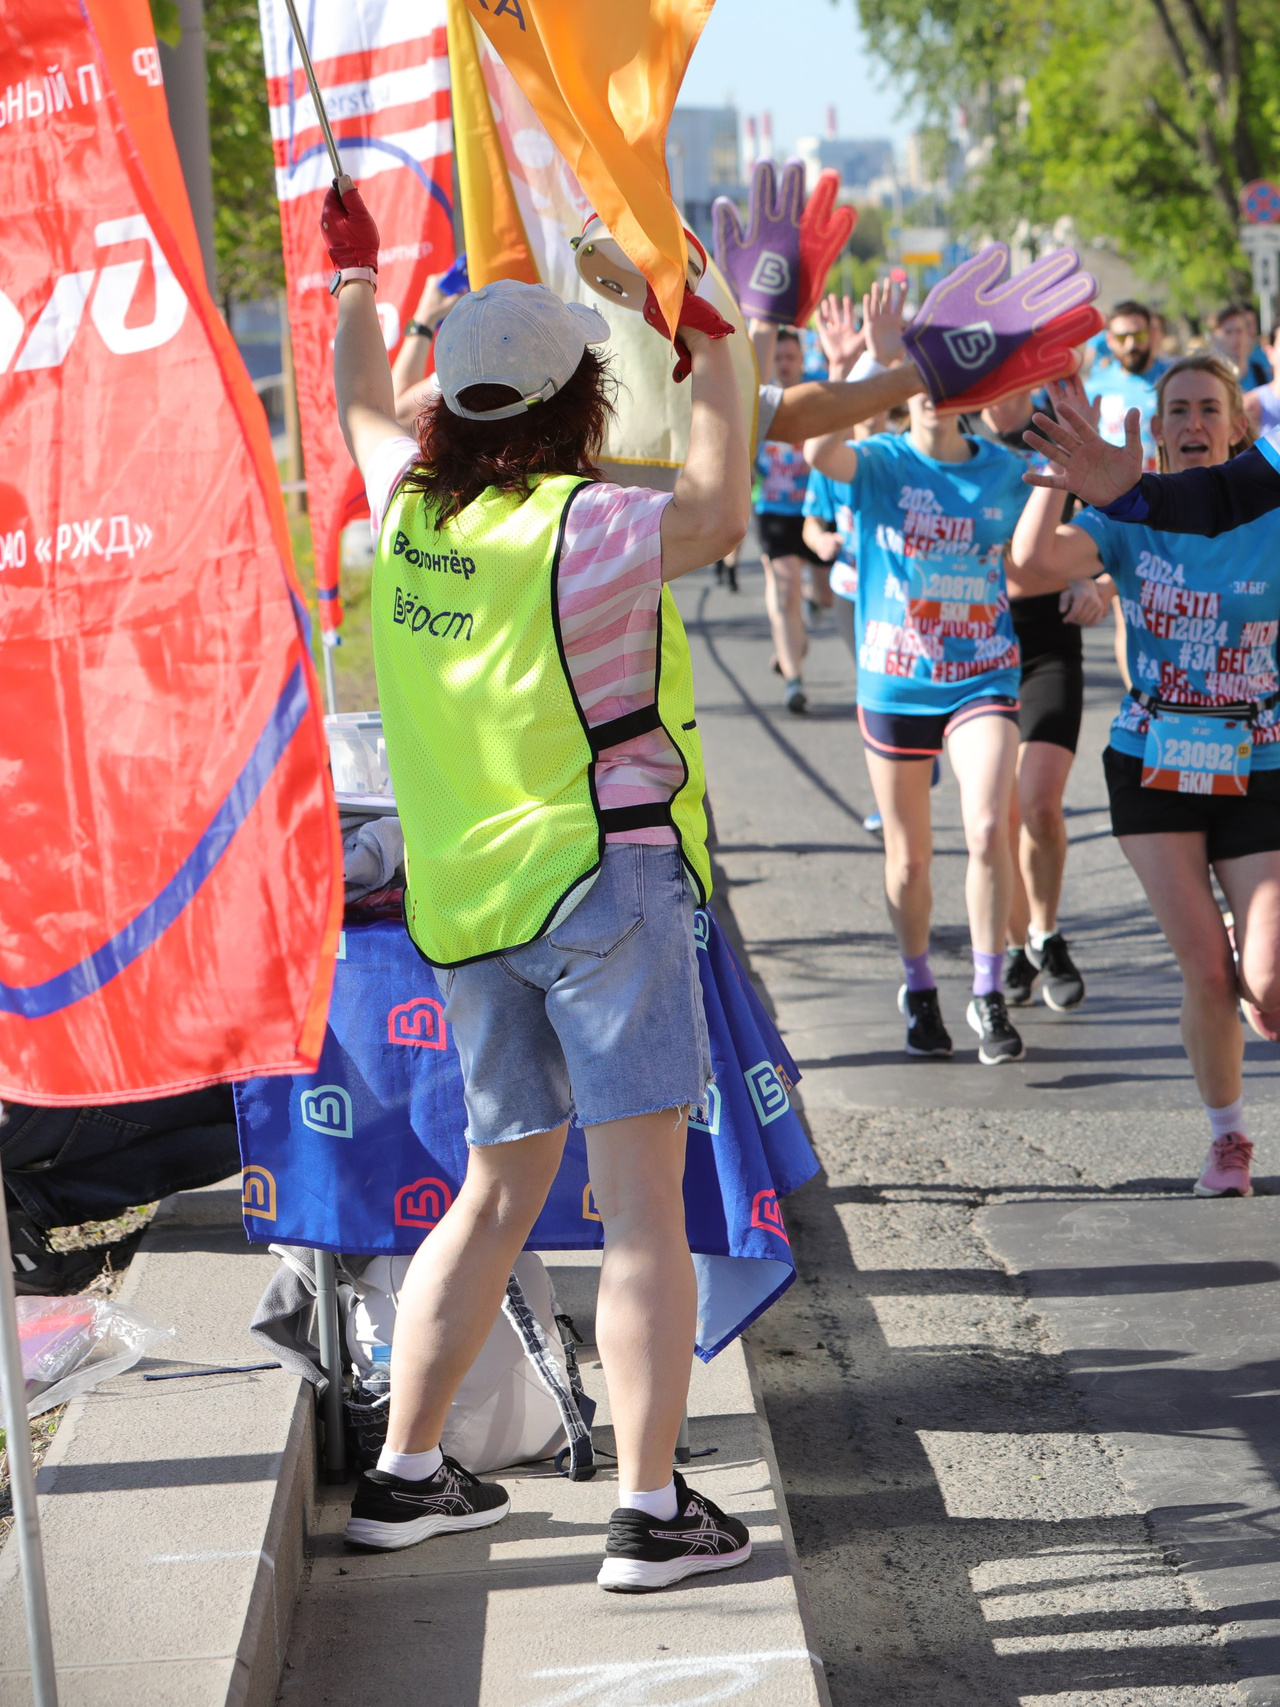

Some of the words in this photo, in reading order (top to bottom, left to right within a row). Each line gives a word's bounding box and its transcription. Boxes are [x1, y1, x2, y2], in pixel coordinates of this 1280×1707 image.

[34, 514, 153, 563] «РЖД»
[1135, 550, 1186, 587] 2024
[1140, 579, 1221, 619] #МЕЧТА
[1164, 738, 1234, 770] 23092
[1177, 770, 1214, 795] 5КМ
